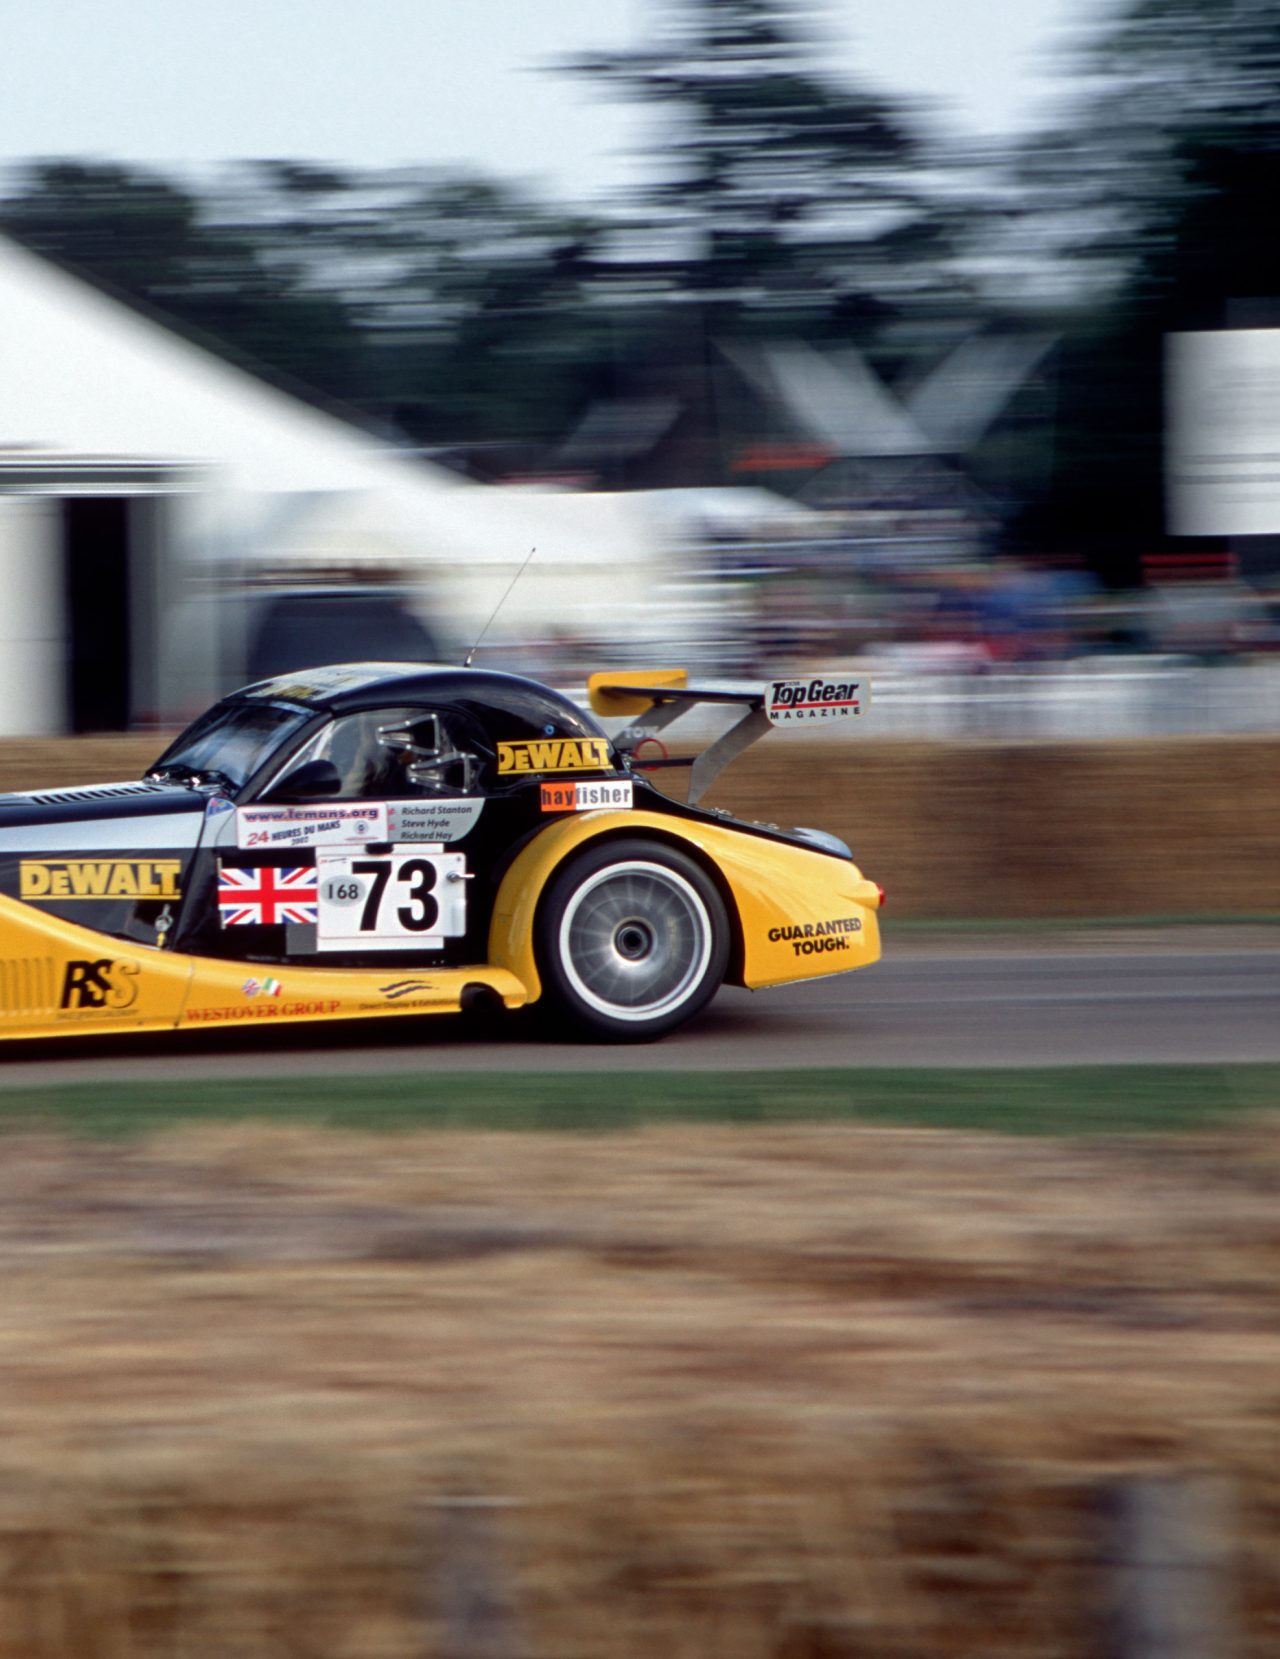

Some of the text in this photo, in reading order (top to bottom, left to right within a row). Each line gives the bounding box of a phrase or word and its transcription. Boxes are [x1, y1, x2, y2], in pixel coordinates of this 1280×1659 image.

[770, 707, 860, 719] MAGAZINE
[243, 808, 379, 821] www.lemans.org
[401, 806, 472, 815] Richard Stanton
[401, 819, 450, 828] Steve Hyde
[247, 820, 341, 846] 24 HEURES DU MANS
[327, 884, 359, 899] 168
[352, 858, 439, 932] 73
[768, 917, 862, 942] GUARANTEED
[185, 1001, 341, 1021] WESTOVER GROUP
